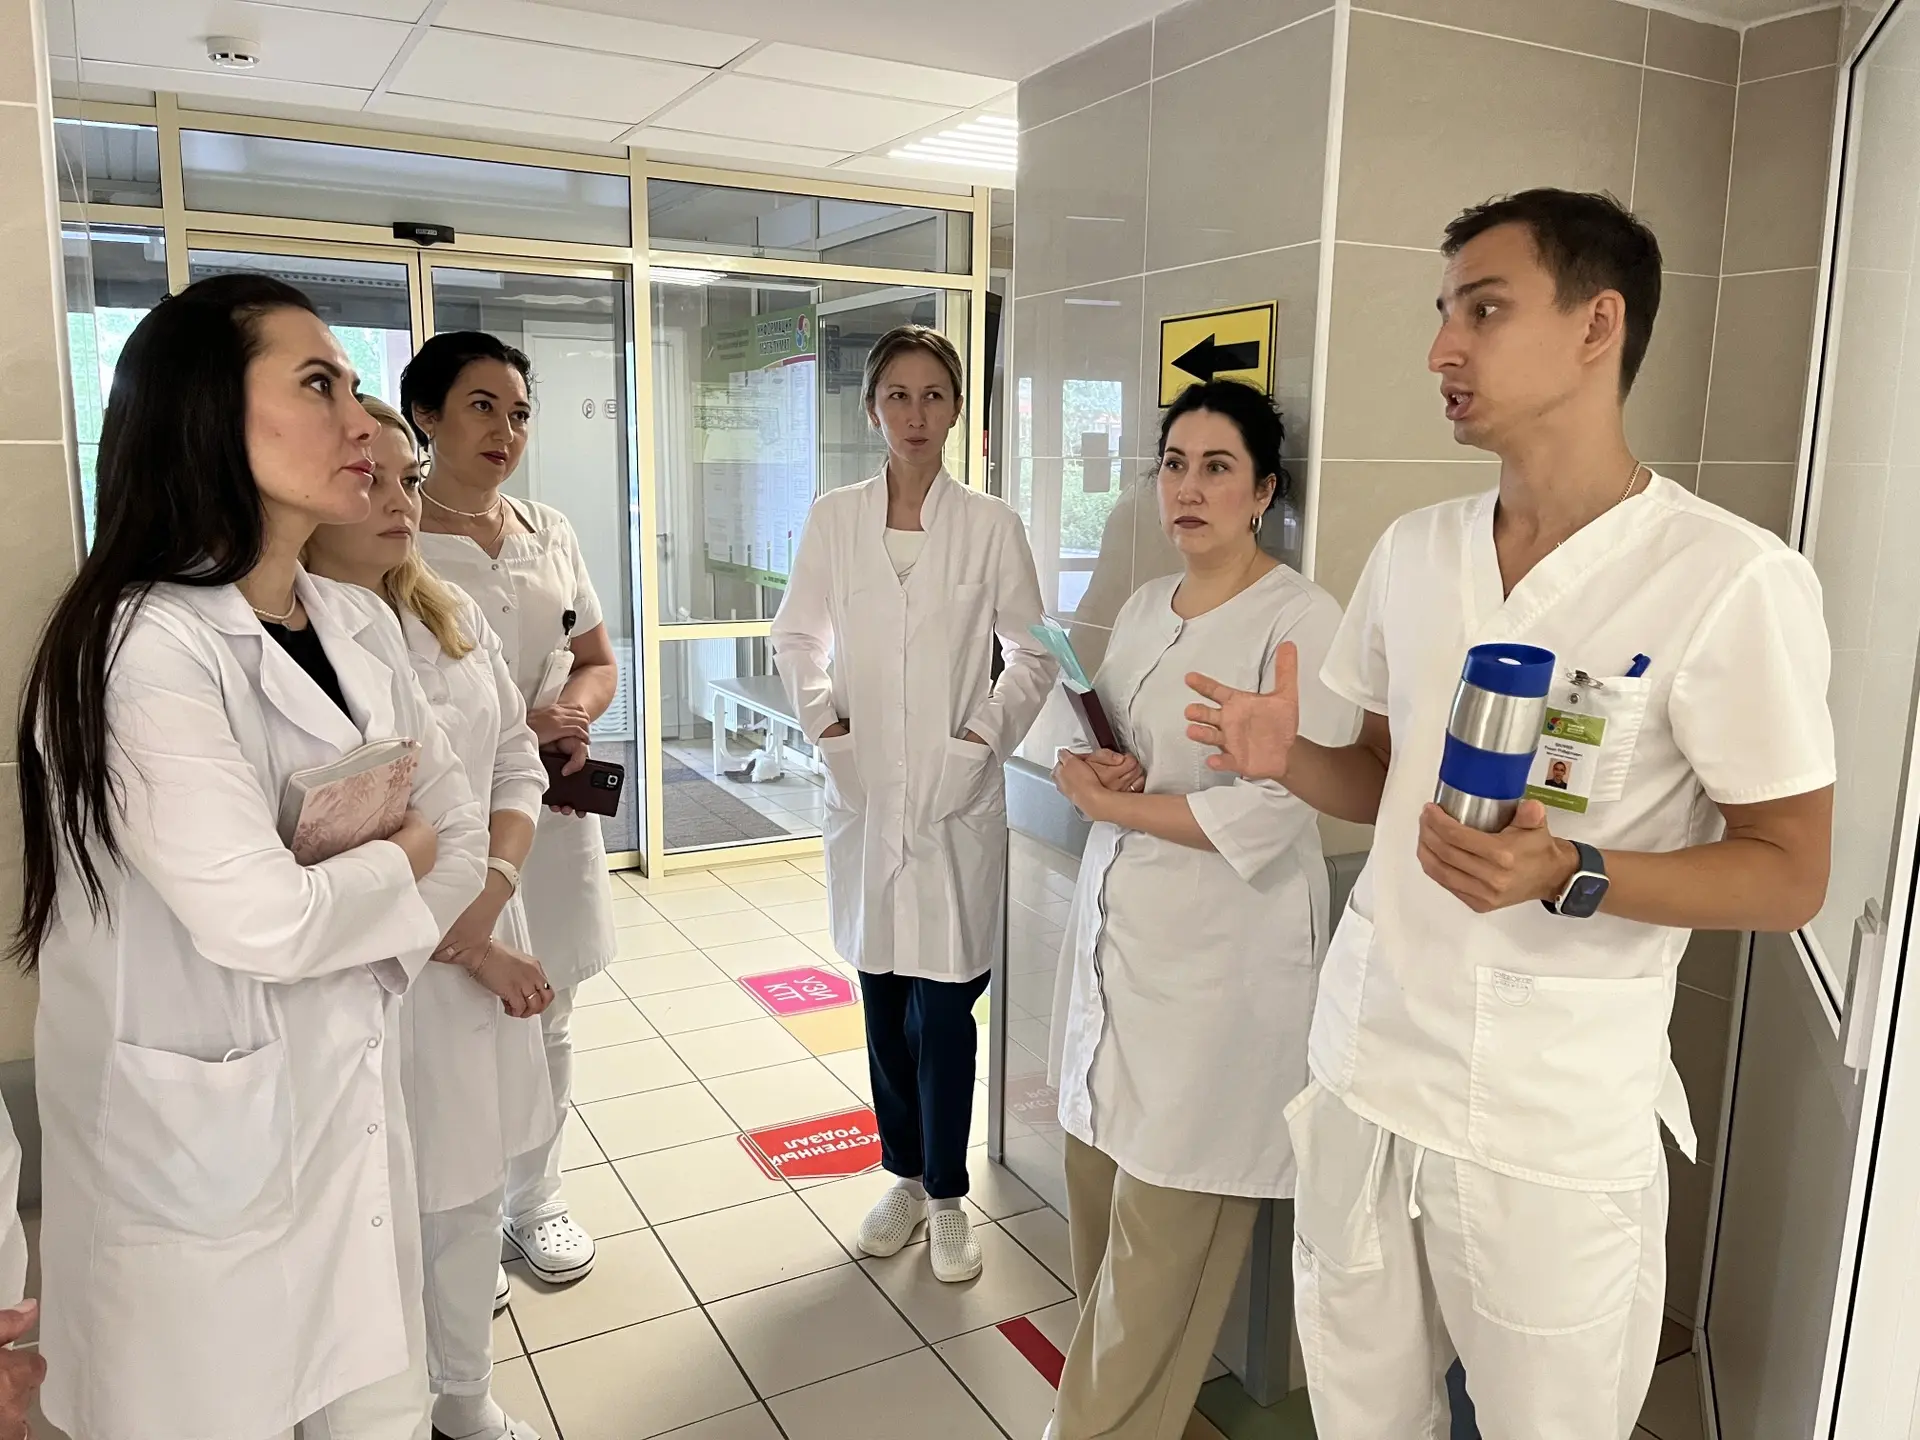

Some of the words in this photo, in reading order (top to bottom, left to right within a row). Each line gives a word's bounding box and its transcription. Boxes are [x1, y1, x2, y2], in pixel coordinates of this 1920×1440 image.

[793, 976, 839, 1001] УЗИ
[770, 1132, 881, 1166] КСТРЕННЫЙ
[783, 1126, 862, 1150] РОДЗАЛ
